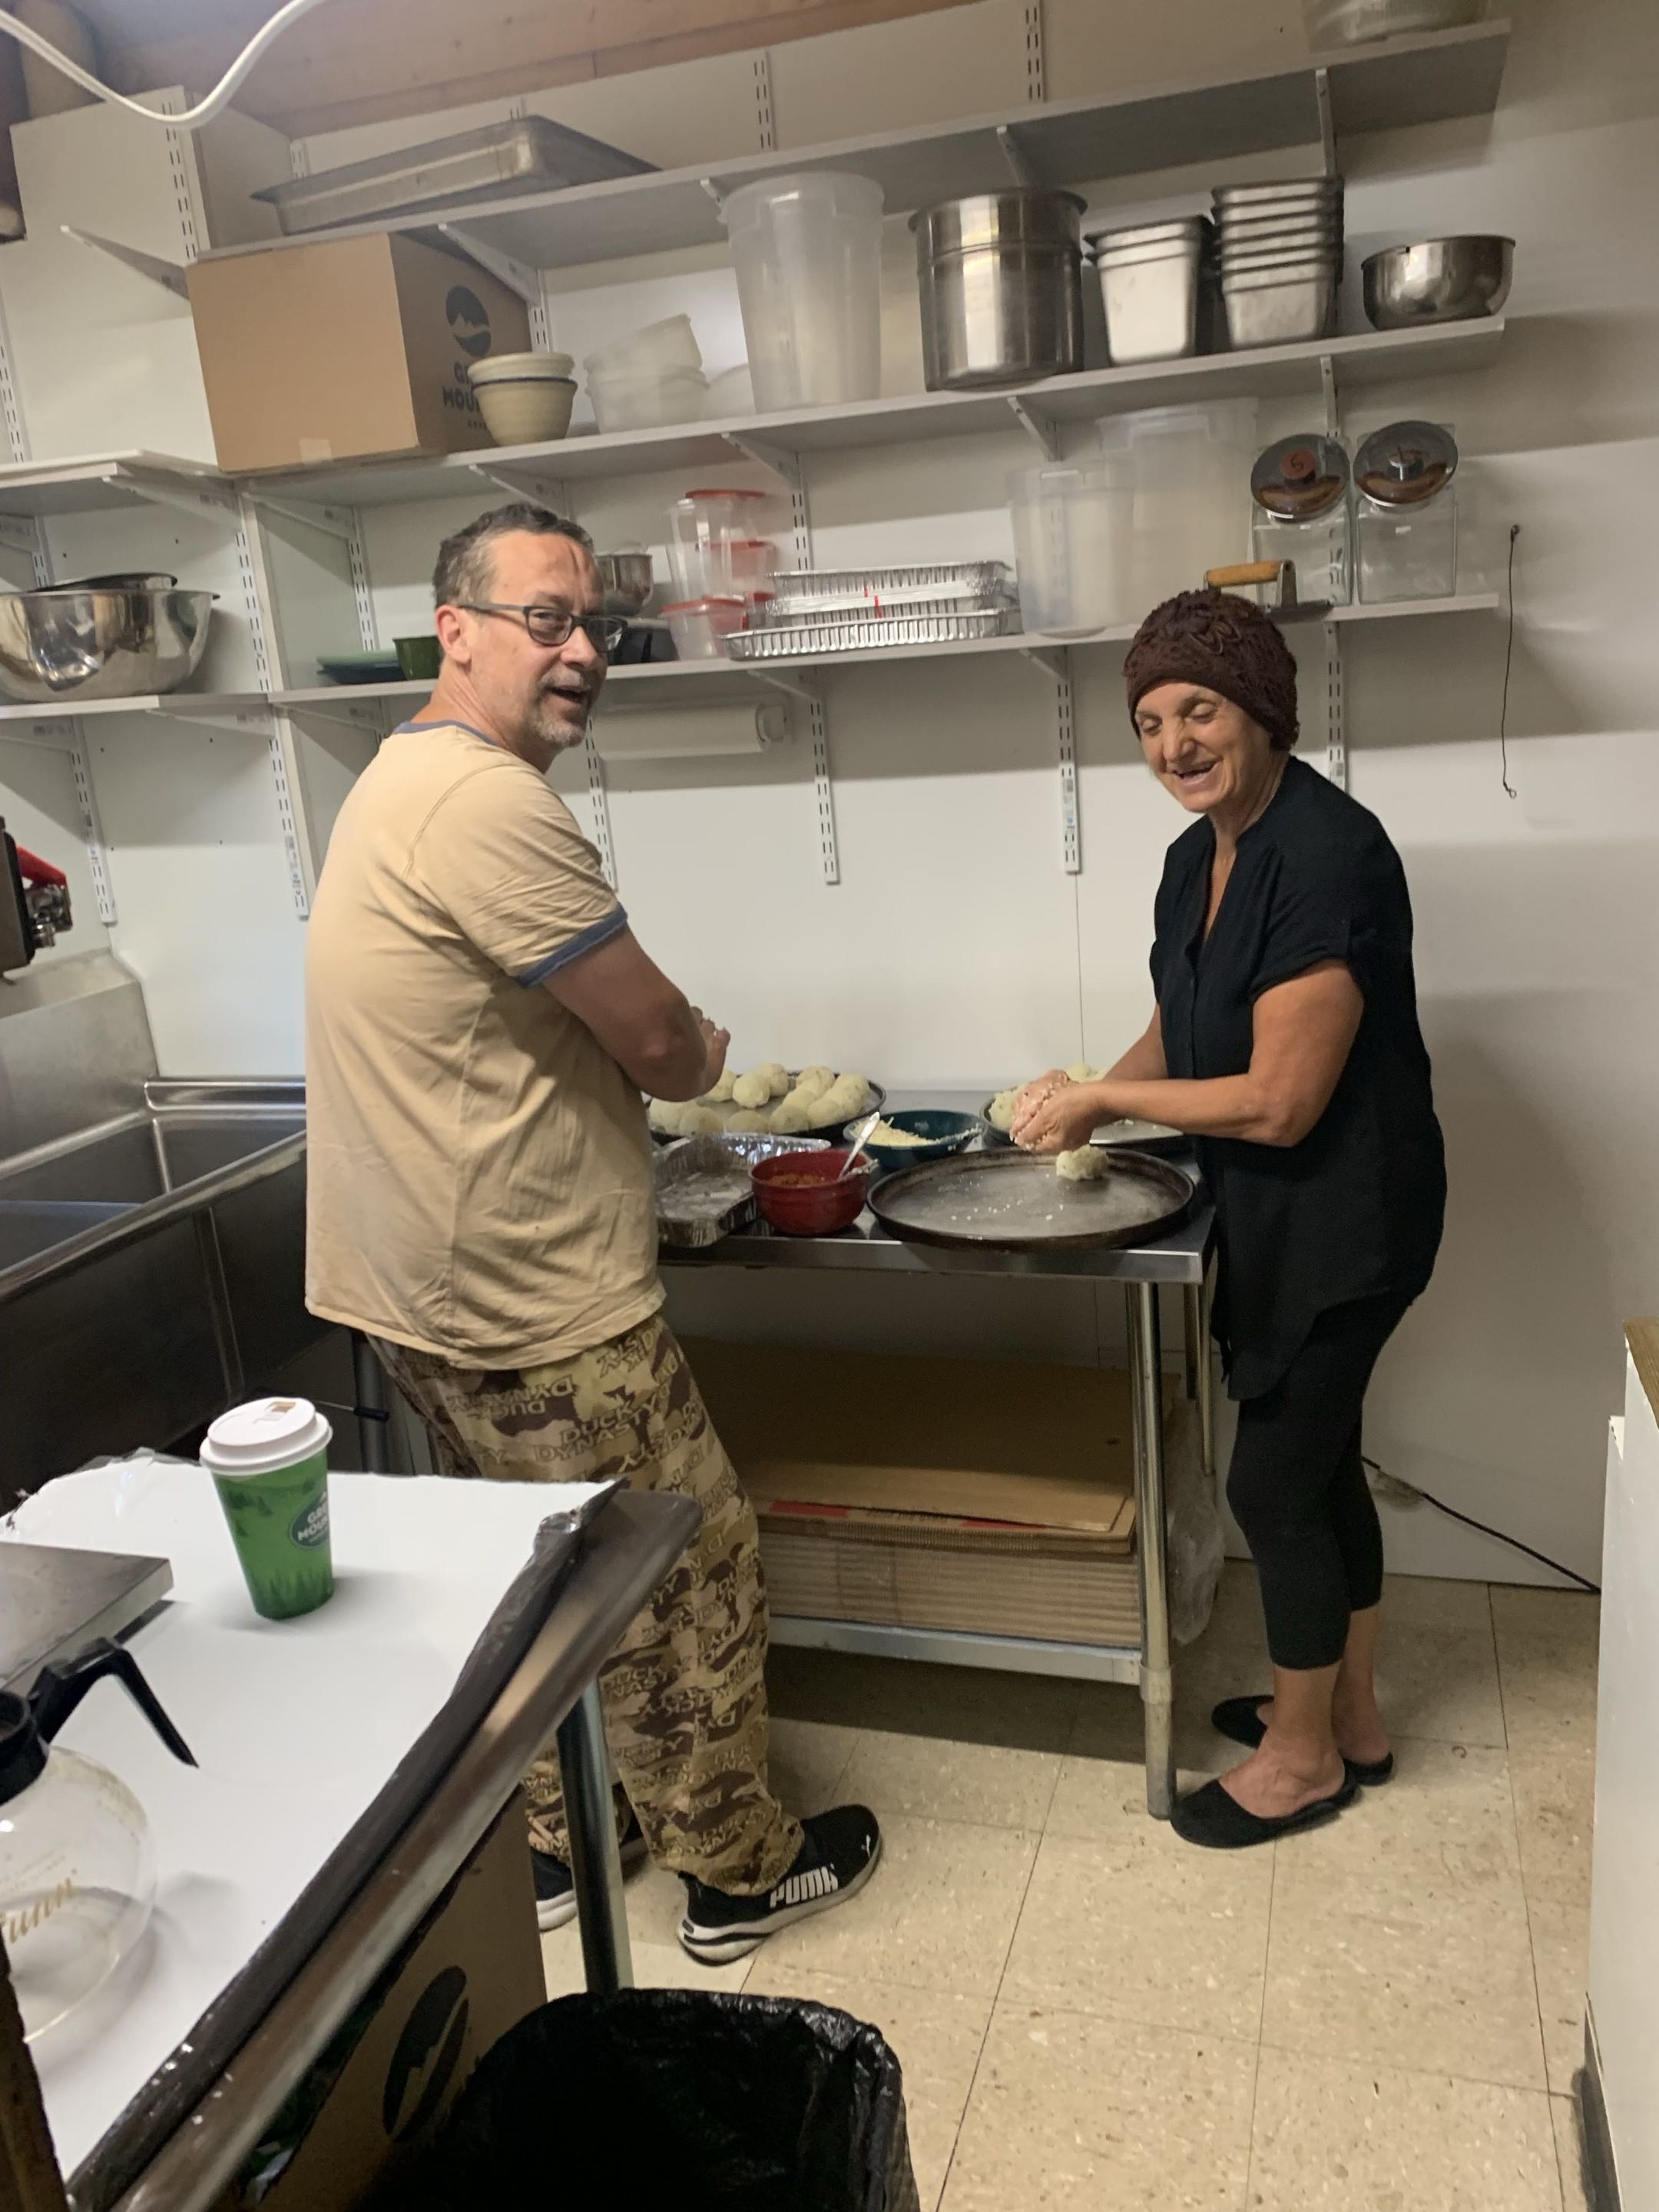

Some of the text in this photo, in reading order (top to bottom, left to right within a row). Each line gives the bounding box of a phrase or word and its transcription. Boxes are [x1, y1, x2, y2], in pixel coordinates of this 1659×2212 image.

[535, 1392, 657, 1462] DYNASTY
[561, 1399, 633, 1444] DUCK
[769, 1865, 839, 1909] PUMA
